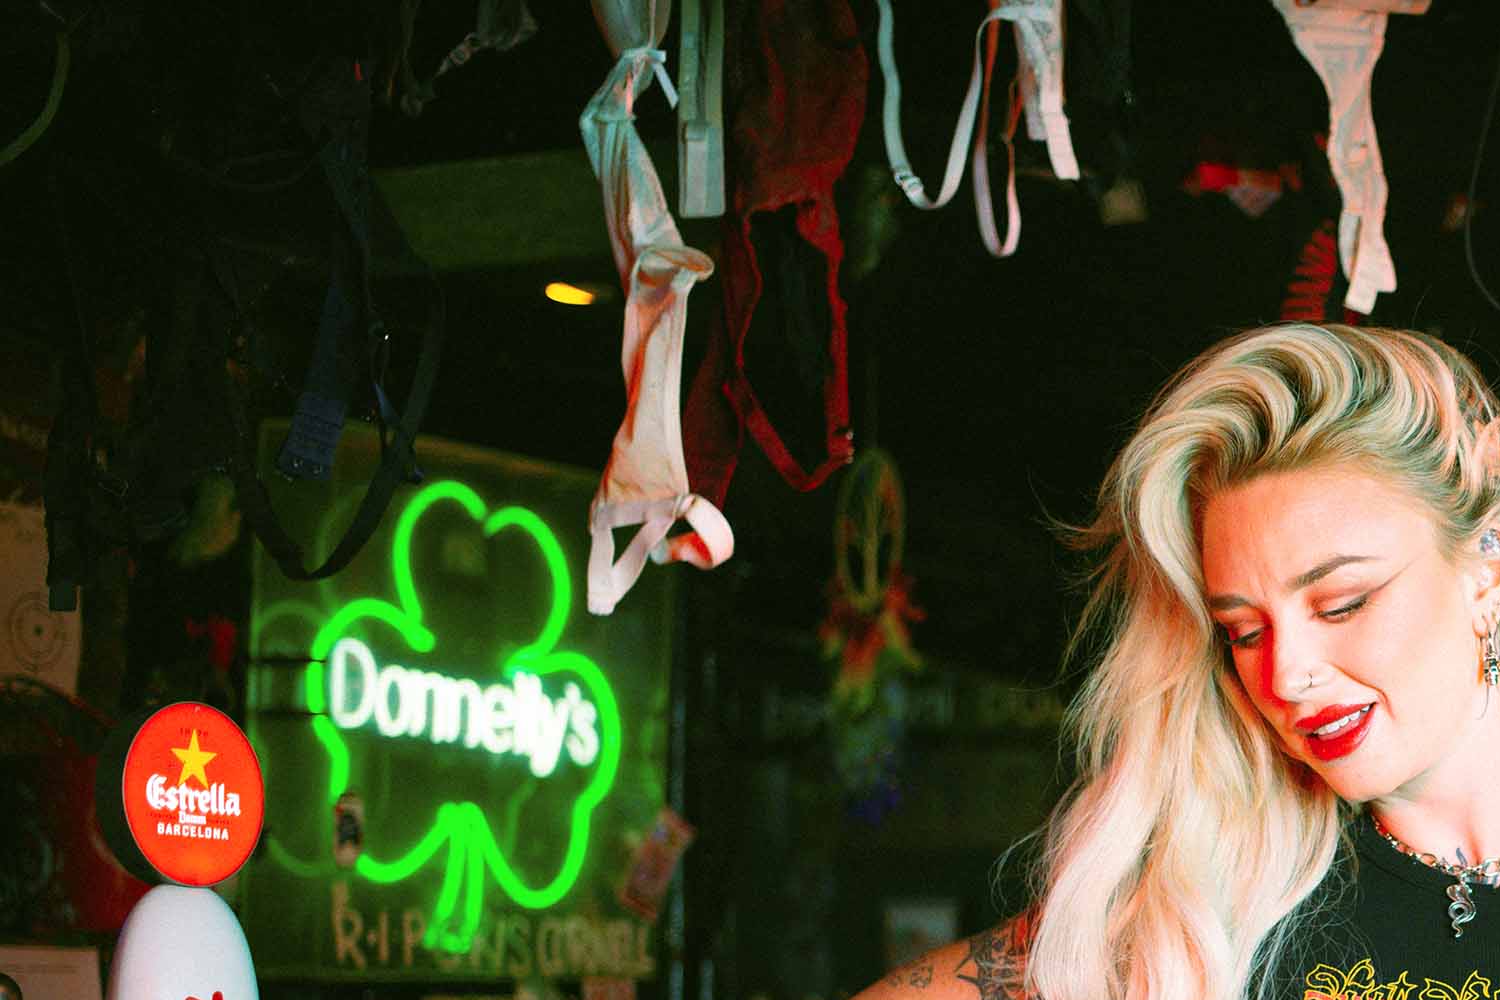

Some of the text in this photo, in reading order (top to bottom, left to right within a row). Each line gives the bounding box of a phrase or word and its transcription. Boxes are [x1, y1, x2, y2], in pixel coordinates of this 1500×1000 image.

[331, 638, 598, 776] Donnelly's
[146, 773, 241, 816] Estrella
[157, 822, 229, 840] BARCELONA
